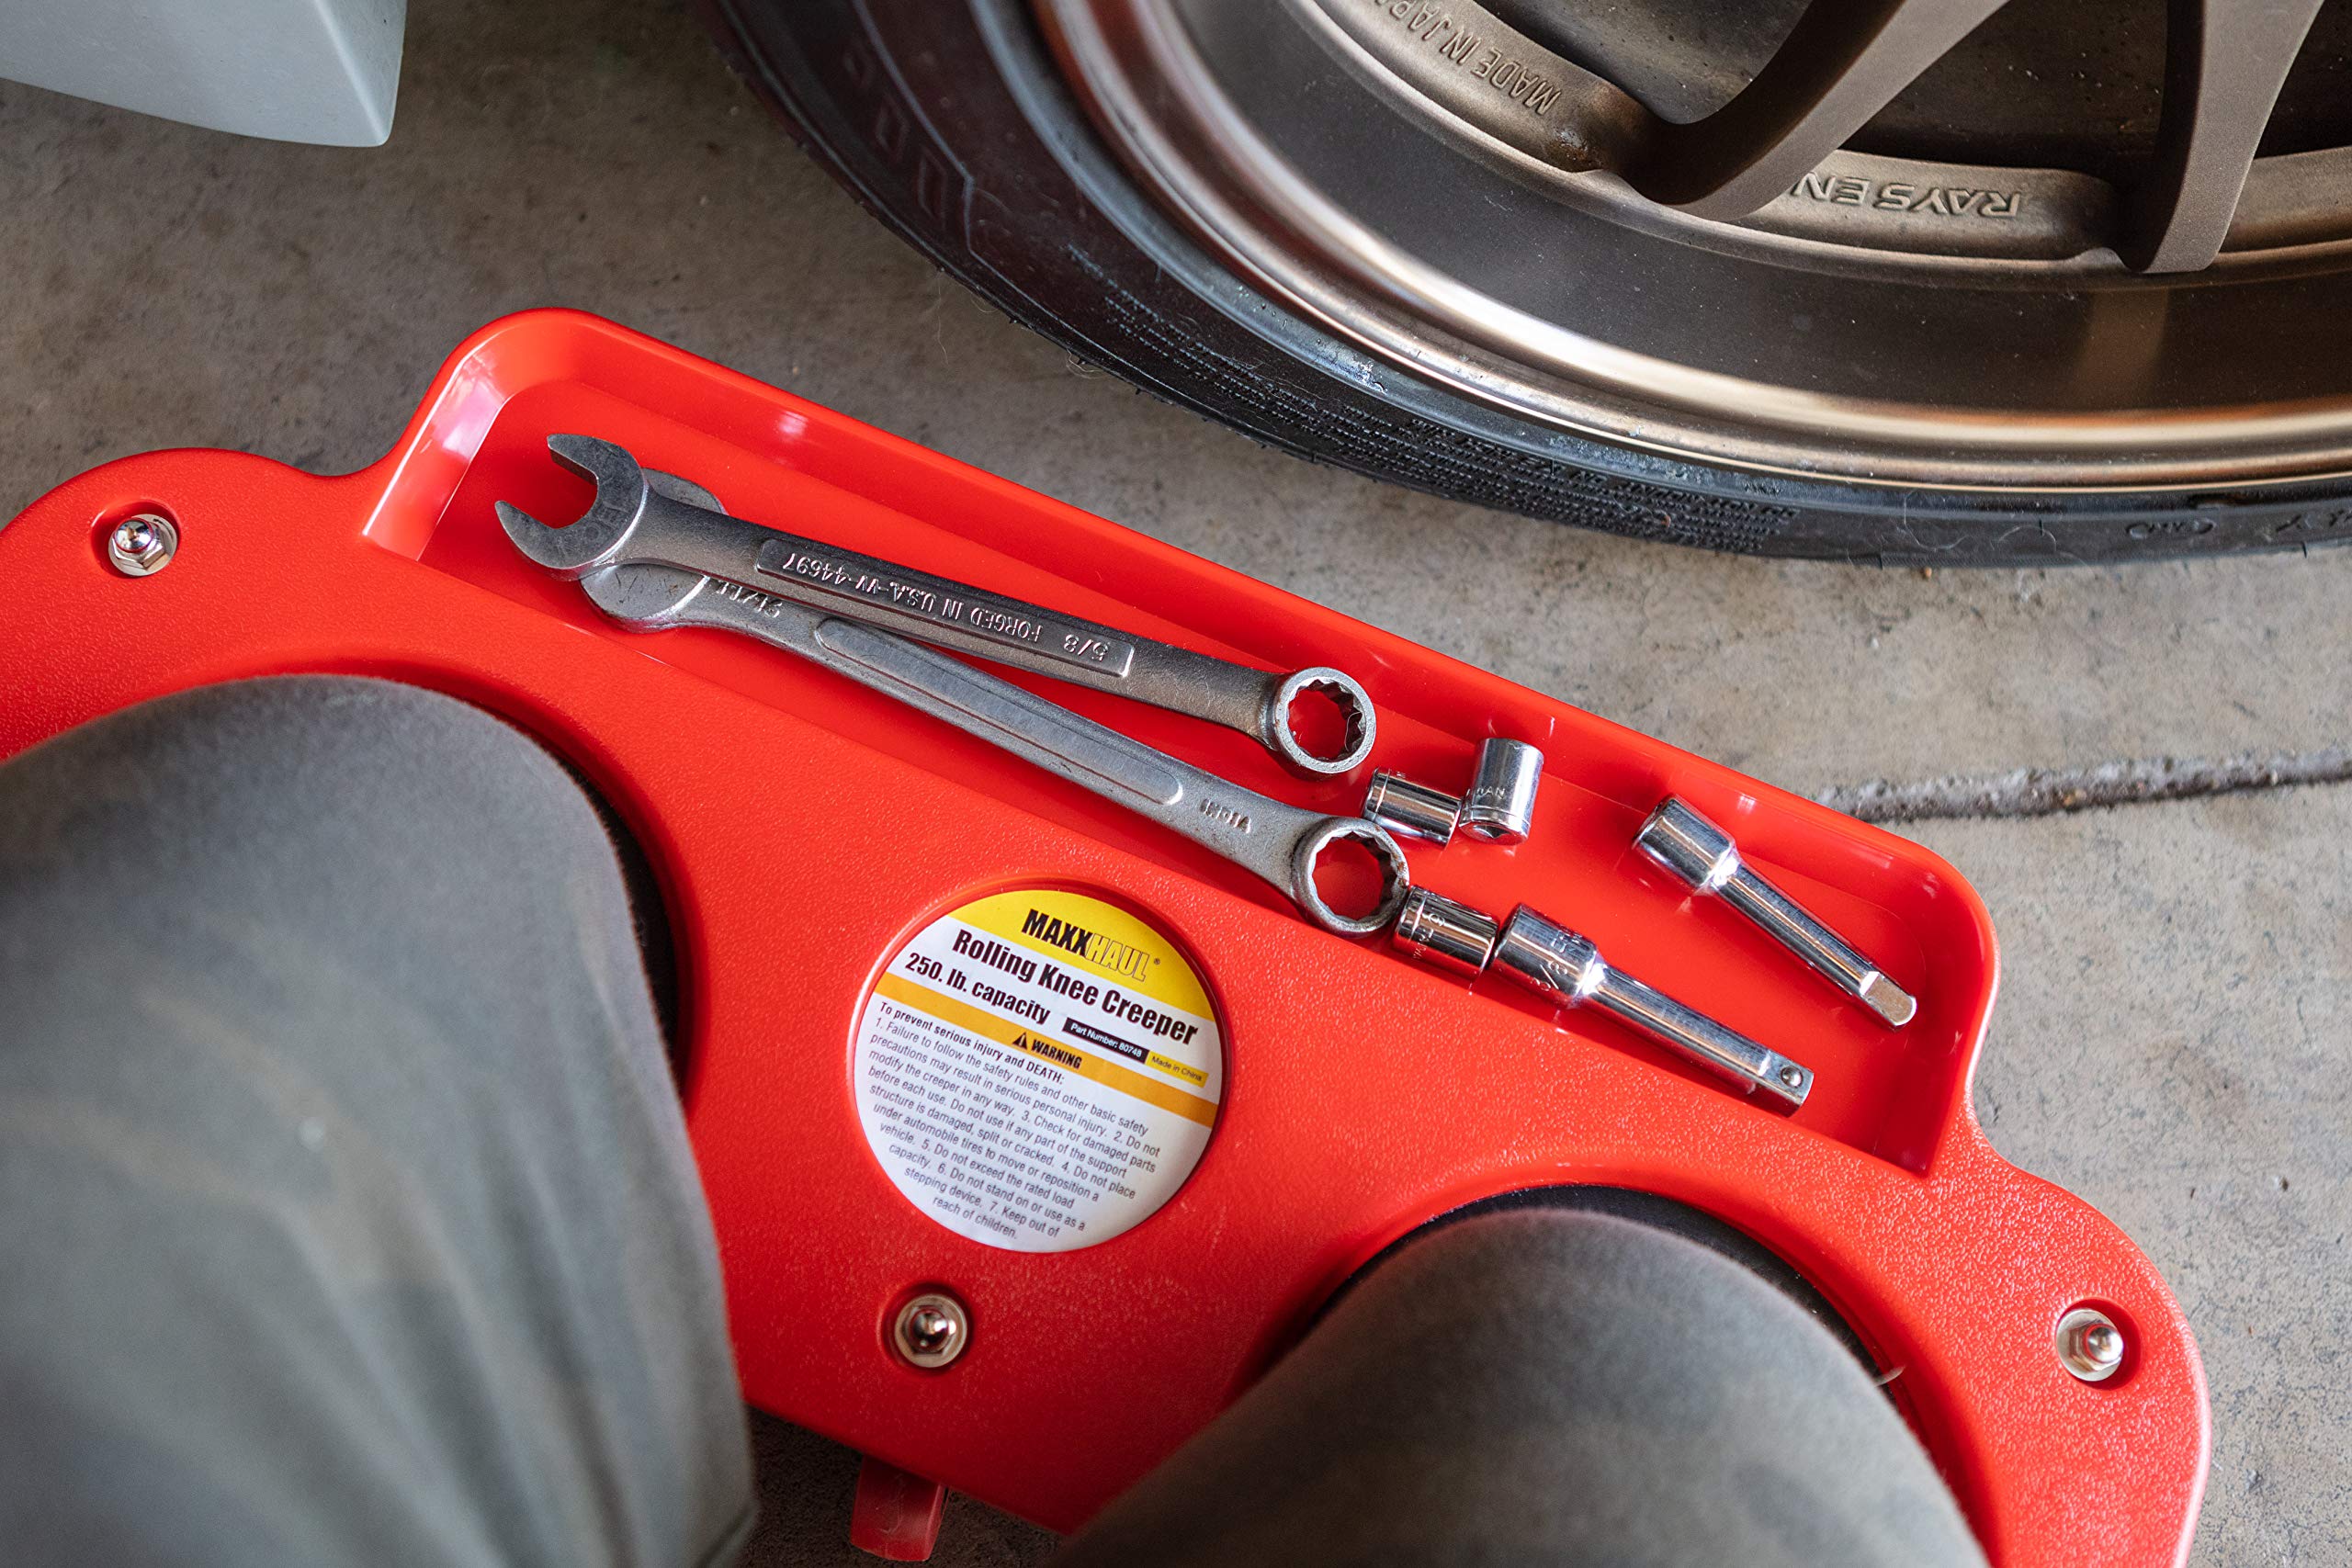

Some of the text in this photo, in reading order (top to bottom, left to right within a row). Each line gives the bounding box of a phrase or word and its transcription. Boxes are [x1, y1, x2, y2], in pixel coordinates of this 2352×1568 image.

[1374, 0, 1562, 116] MADE IN JAP
[1872, 182, 2022, 218] RAYS
[942, 596, 965, 621] IN
[970, 606, 1043, 643] FORGED
[1063, 633, 1111, 662] 5/8
[904, 952, 1051, 1025] 250. lb. capacity
[952, 929, 1198, 1045] Rolling Knee Creeper
[876, 1017, 1148, 1137] 1. Failure to follow the safety rules and other basic safety
[880, 1001, 1064, 1085] To prevent serious injury and DEATH:
[1031, 1038, 1082, 1069] WARNING
[1069, 1022, 1087, 1035] Part
[1086, 1029, 1119, 1048] Number:
[1150, 1055, 1203, 1082] Made in China
[867, 1065, 1127, 1179] before each use. Do not use if any part of the support
[868, 1050, 1156, 1173] modify the creeper in any way. 3. Check for damaged parts
[869, 1033, 1160, 1157] precautions may result in serious personal injury. 2. Do not
[869, 1085, 1136, 1200] structure is damaged, split or cracked. 4. Do not place
[873, 1103, 1099, 1201] under automobile tires to move or reposition a
[880, 1122, 1075, 1209] vehicle. 5. Do not exceed the rated load
[888, 1144, 1086, 1231] capacity. 6. Do not stand on or use as a
[904, 1168, 1060, 1237] stepping device. 7. Keep out of
[933, 1196, 1016, 1239] reach of children.
